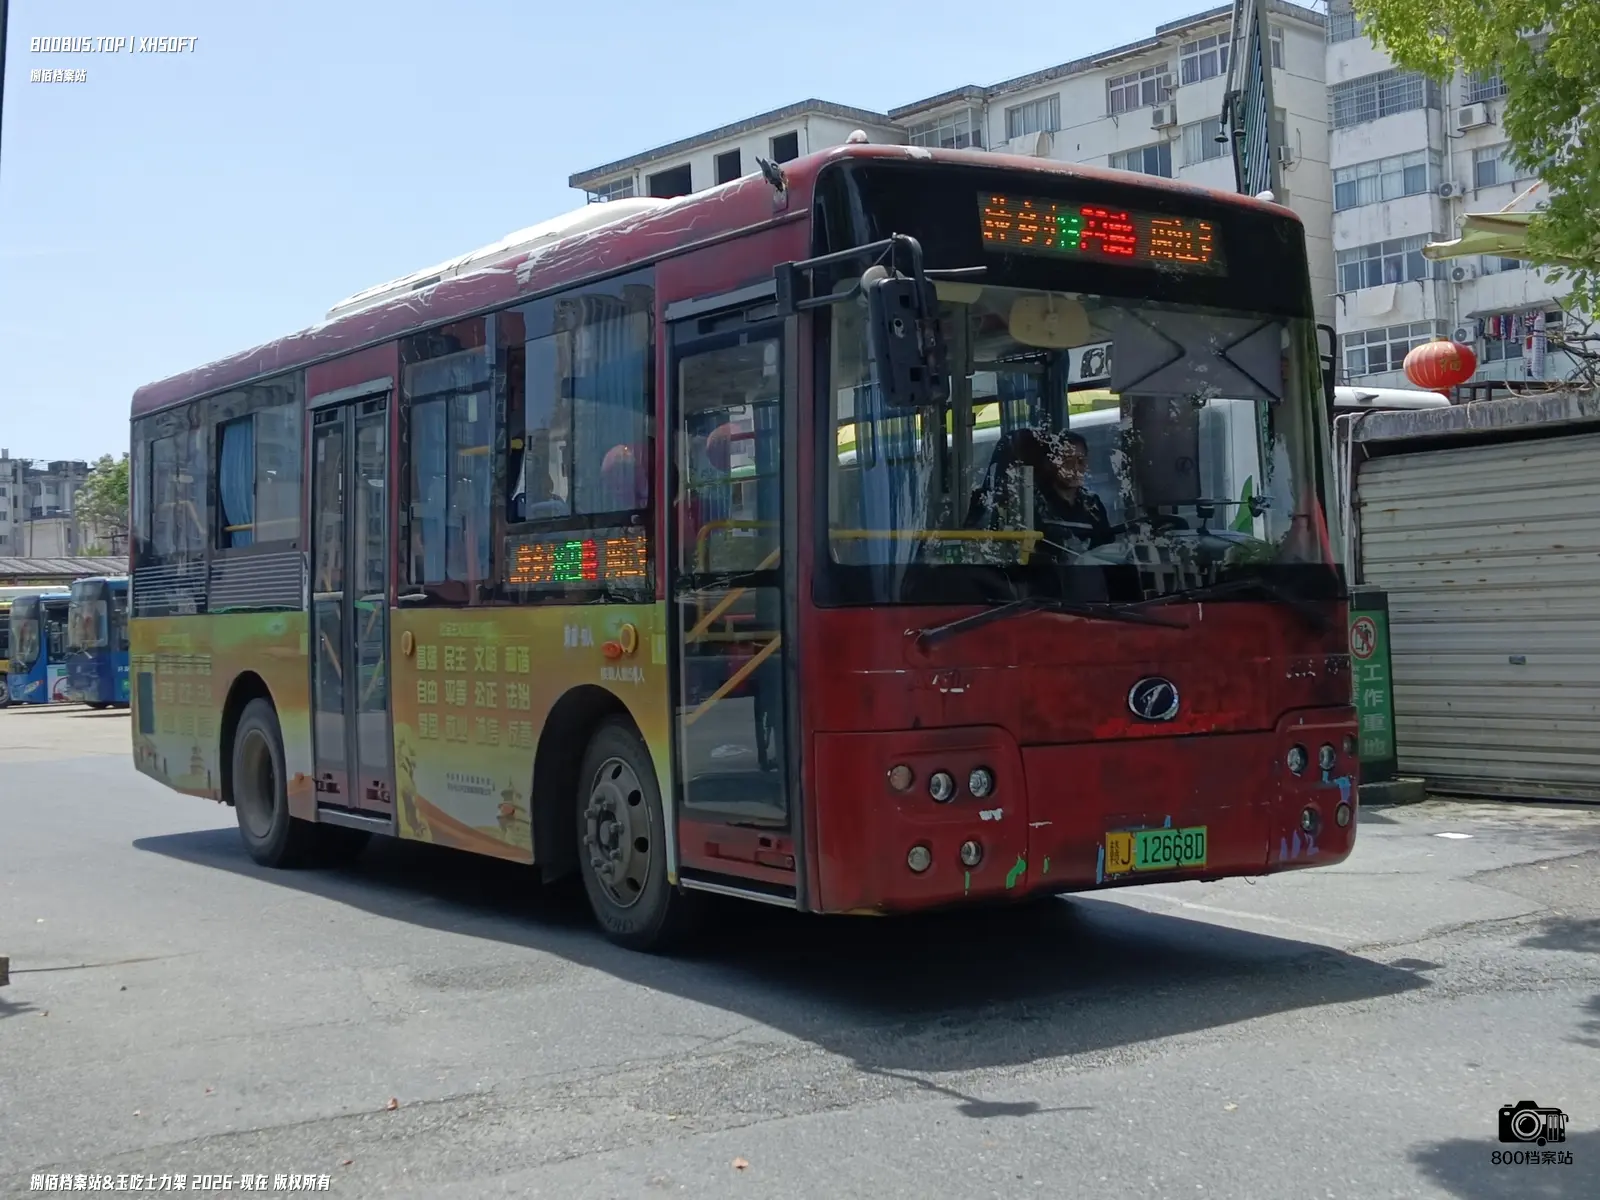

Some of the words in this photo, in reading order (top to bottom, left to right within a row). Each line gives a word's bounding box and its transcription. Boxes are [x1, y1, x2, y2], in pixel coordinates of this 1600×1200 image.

[444, 645, 467, 671] 民主
[417, 679, 438, 704] 自由
[1363, 664, 1387, 757] 工作重地
